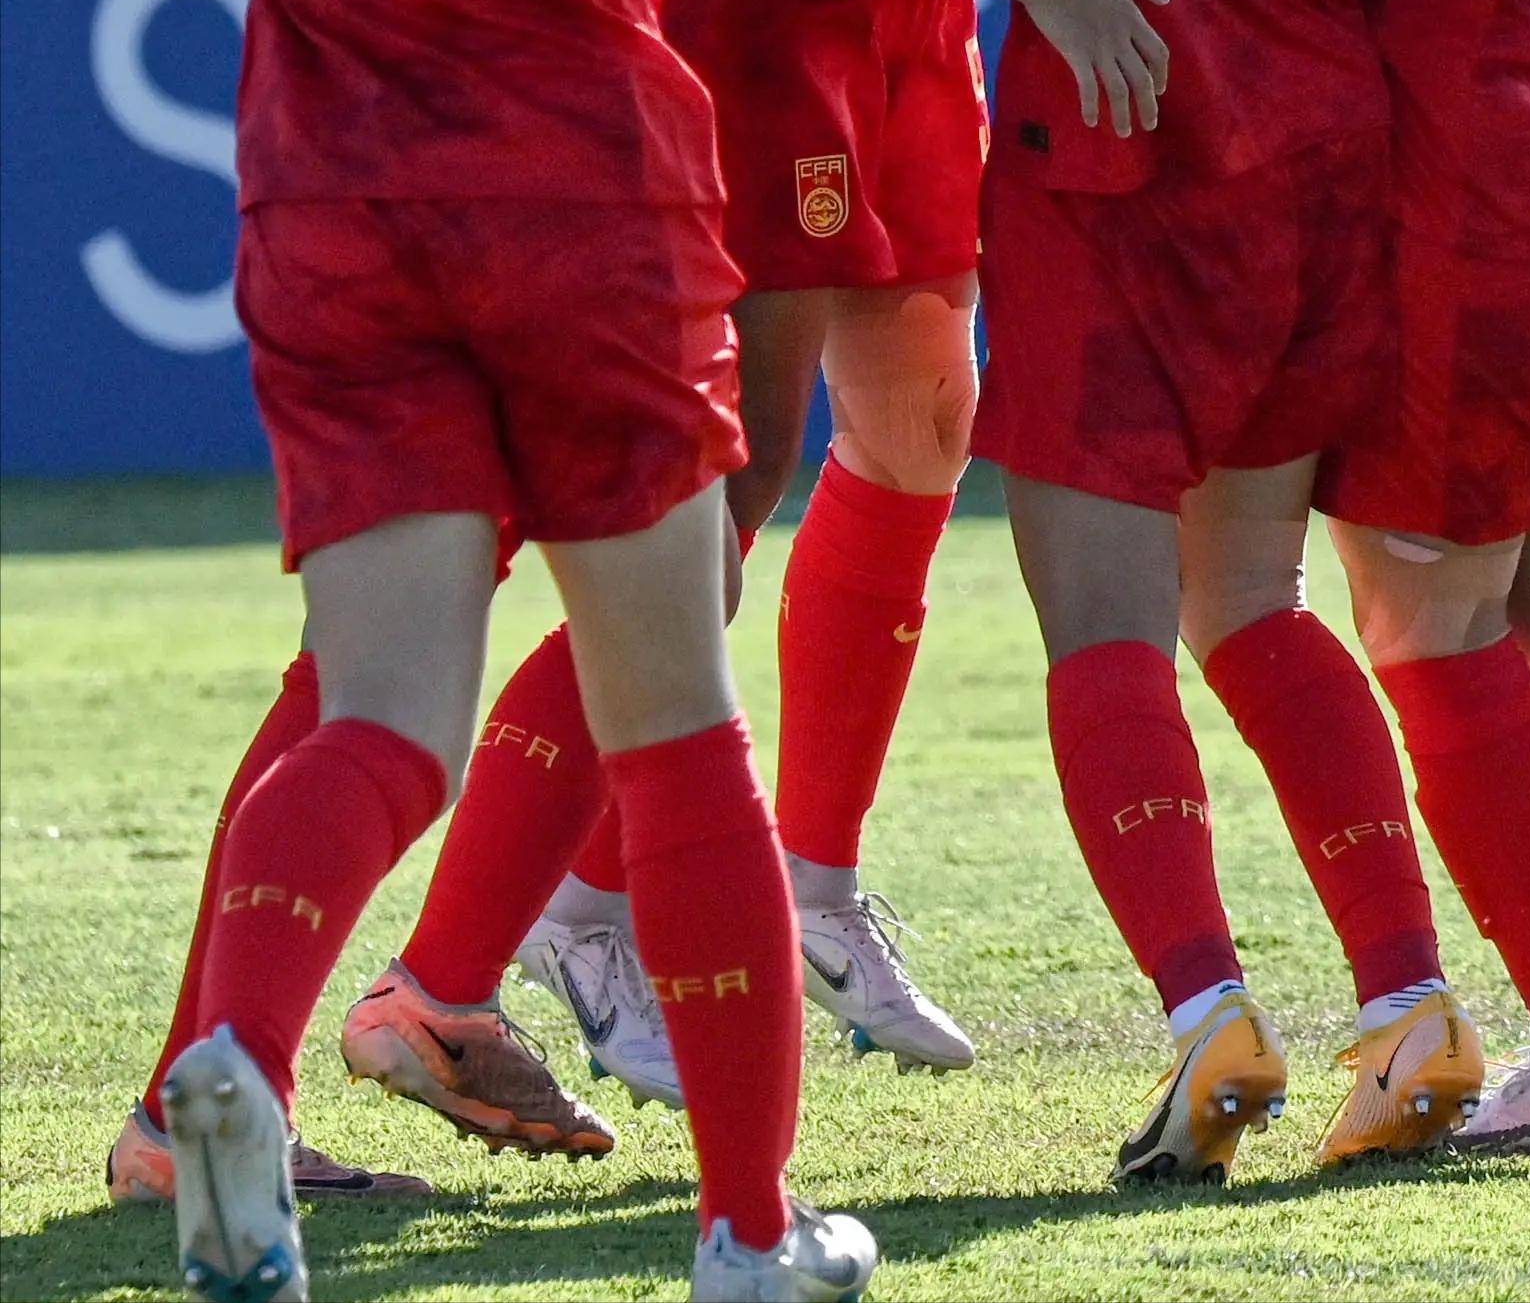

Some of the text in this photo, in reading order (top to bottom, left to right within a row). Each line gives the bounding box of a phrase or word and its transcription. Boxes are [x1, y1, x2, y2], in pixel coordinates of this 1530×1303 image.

[800, 159, 843, 179] CFA
[476, 721, 560, 770] CFA
[1112, 797, 1205, 835] CFA
[1319, 820, 1408, 860] CFA
[221, 884, 323, 931] CFA
[649, 967, 750, 1003] CFA
